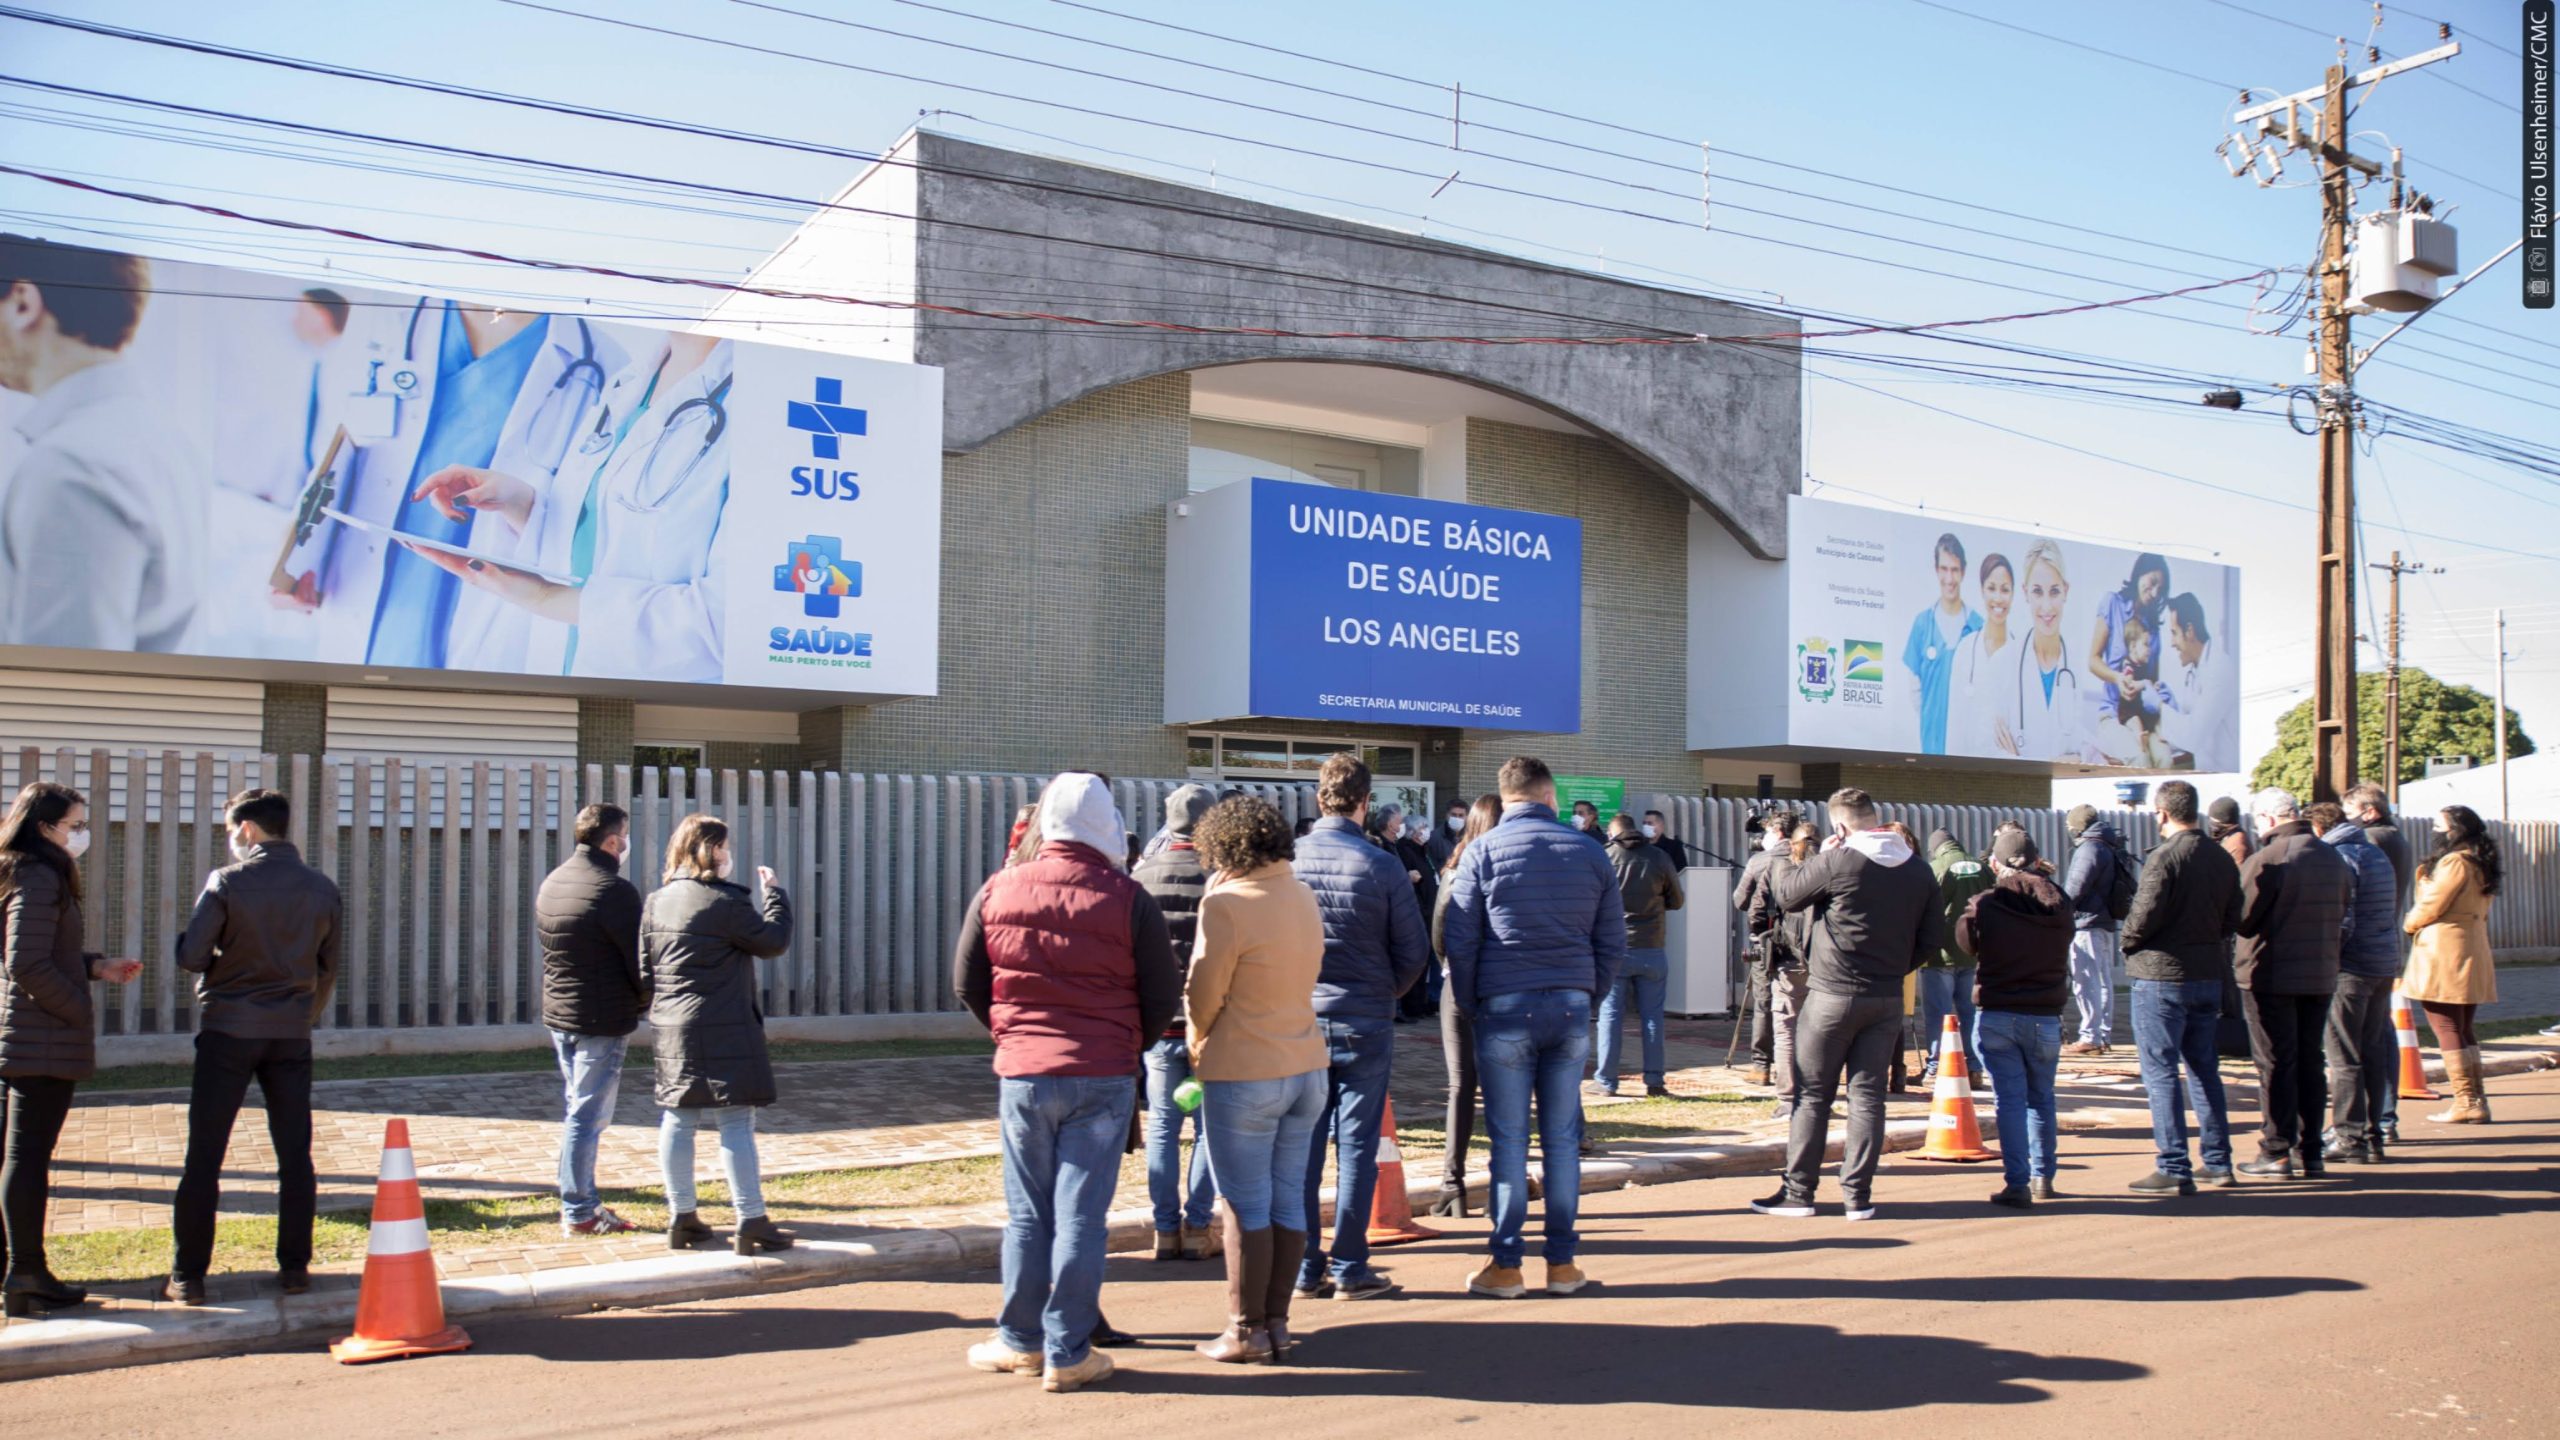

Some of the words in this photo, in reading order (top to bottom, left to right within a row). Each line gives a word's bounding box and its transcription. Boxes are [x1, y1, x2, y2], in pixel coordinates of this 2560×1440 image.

[790, 465, 860, 501] SUS
[1289, 503, 1431, 547] UNIDADE
[1443, 519, 1552, 562] BÁSICA
[1348, 561, 1390, 592] DE
[1397, 564, 1500, 602] SAÚDE
[769, 625, 873, 657] SAÚDE
[1323, 616, 1381, 646] LOS
[1388, 622, 1521, 657] ANGELES
[769, 655, 794, 664] MAIS
[797, 656, 829, 667] PERTO
[831, 659, 844, 668] DE
[1319, 694, 1396, 710] SECRETARIA
[1398, 699, 1462, 714] MUNICIPAL
[1465, 703, 1481, 715] DE
[1483, 703, 1522, 718] SAÚDE
[1843, 689, 1883, 705] BRASIL
